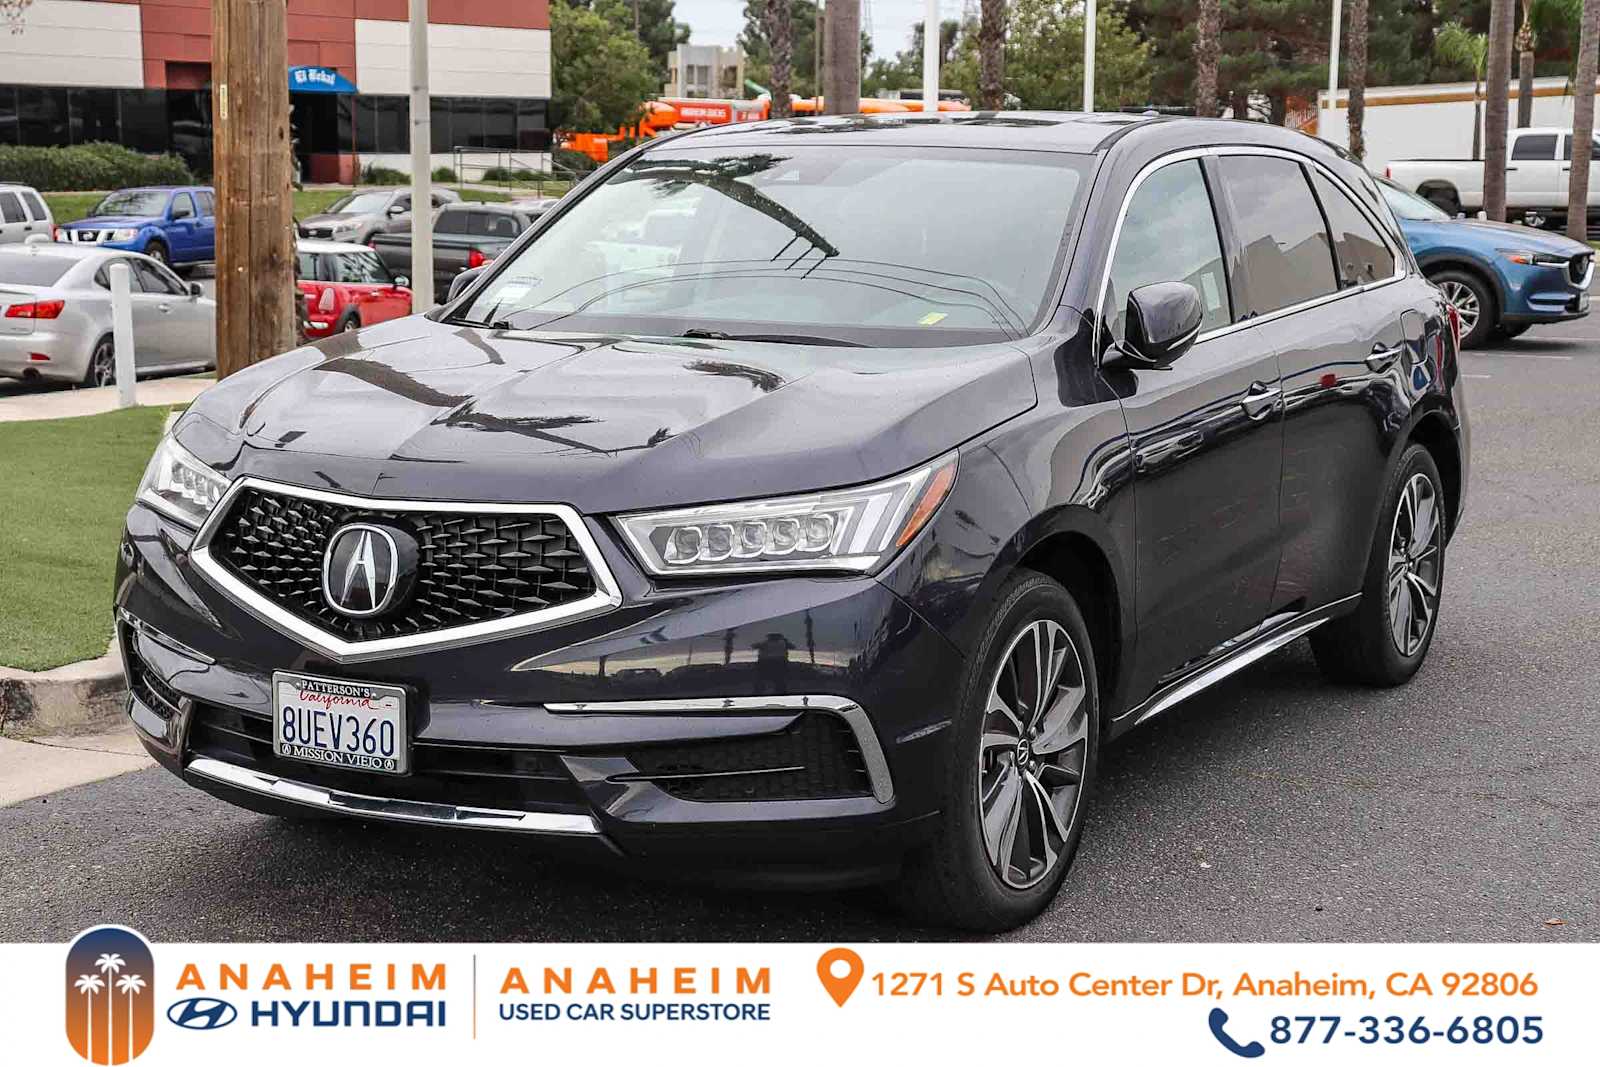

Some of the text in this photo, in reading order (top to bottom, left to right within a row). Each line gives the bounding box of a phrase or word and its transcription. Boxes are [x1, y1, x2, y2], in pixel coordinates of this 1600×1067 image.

[301, 680, 371, 697] PATTERSON'S
[282, 705, 395, 757] 8UEV360
[293, 746, 383, 769] MISSION VIEJO
